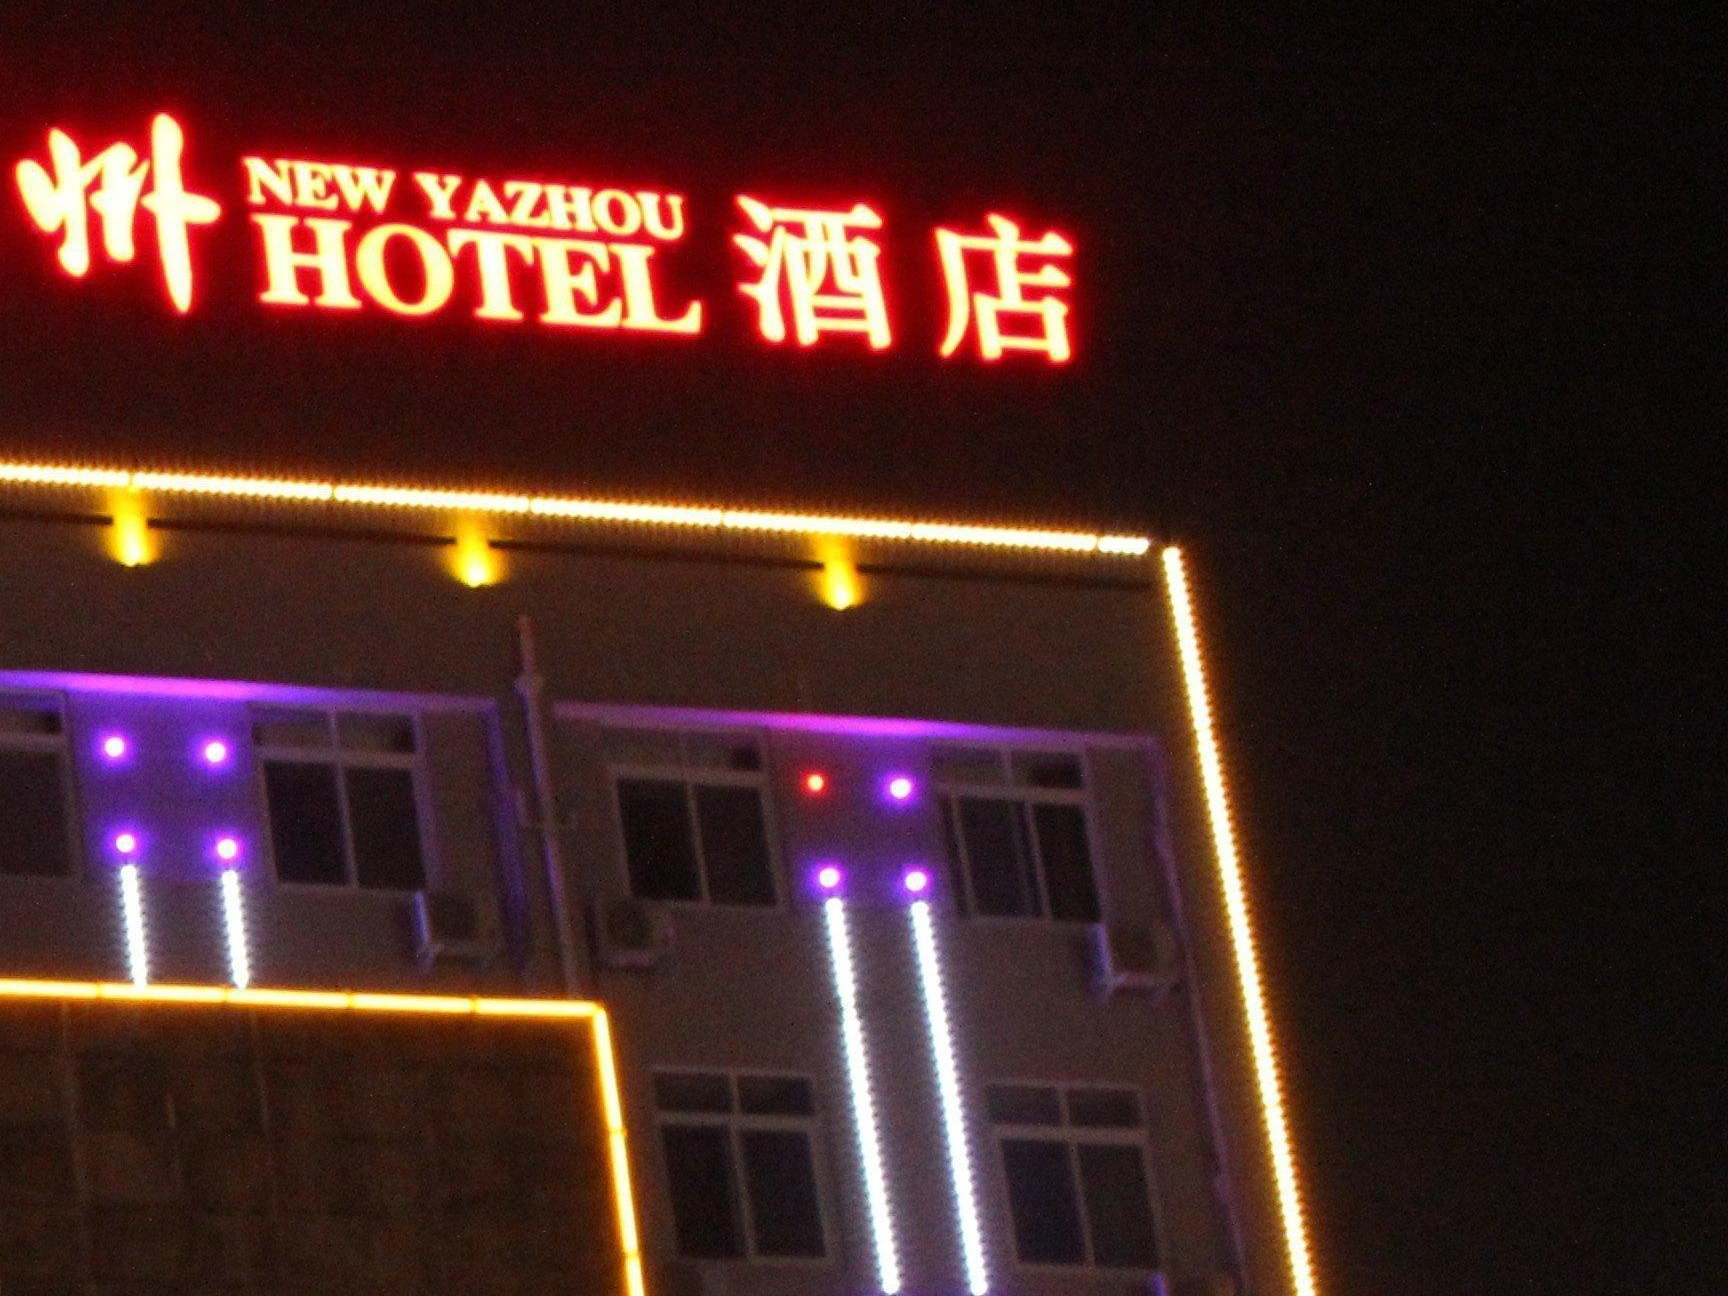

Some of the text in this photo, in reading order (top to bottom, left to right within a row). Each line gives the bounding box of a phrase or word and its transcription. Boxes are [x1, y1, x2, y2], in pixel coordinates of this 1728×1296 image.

[241, 155, 686, 242] NEW YAZHOU
[250, 212, 703, 336] HOTEL
[731, 194, 1074, 364] 酒店
